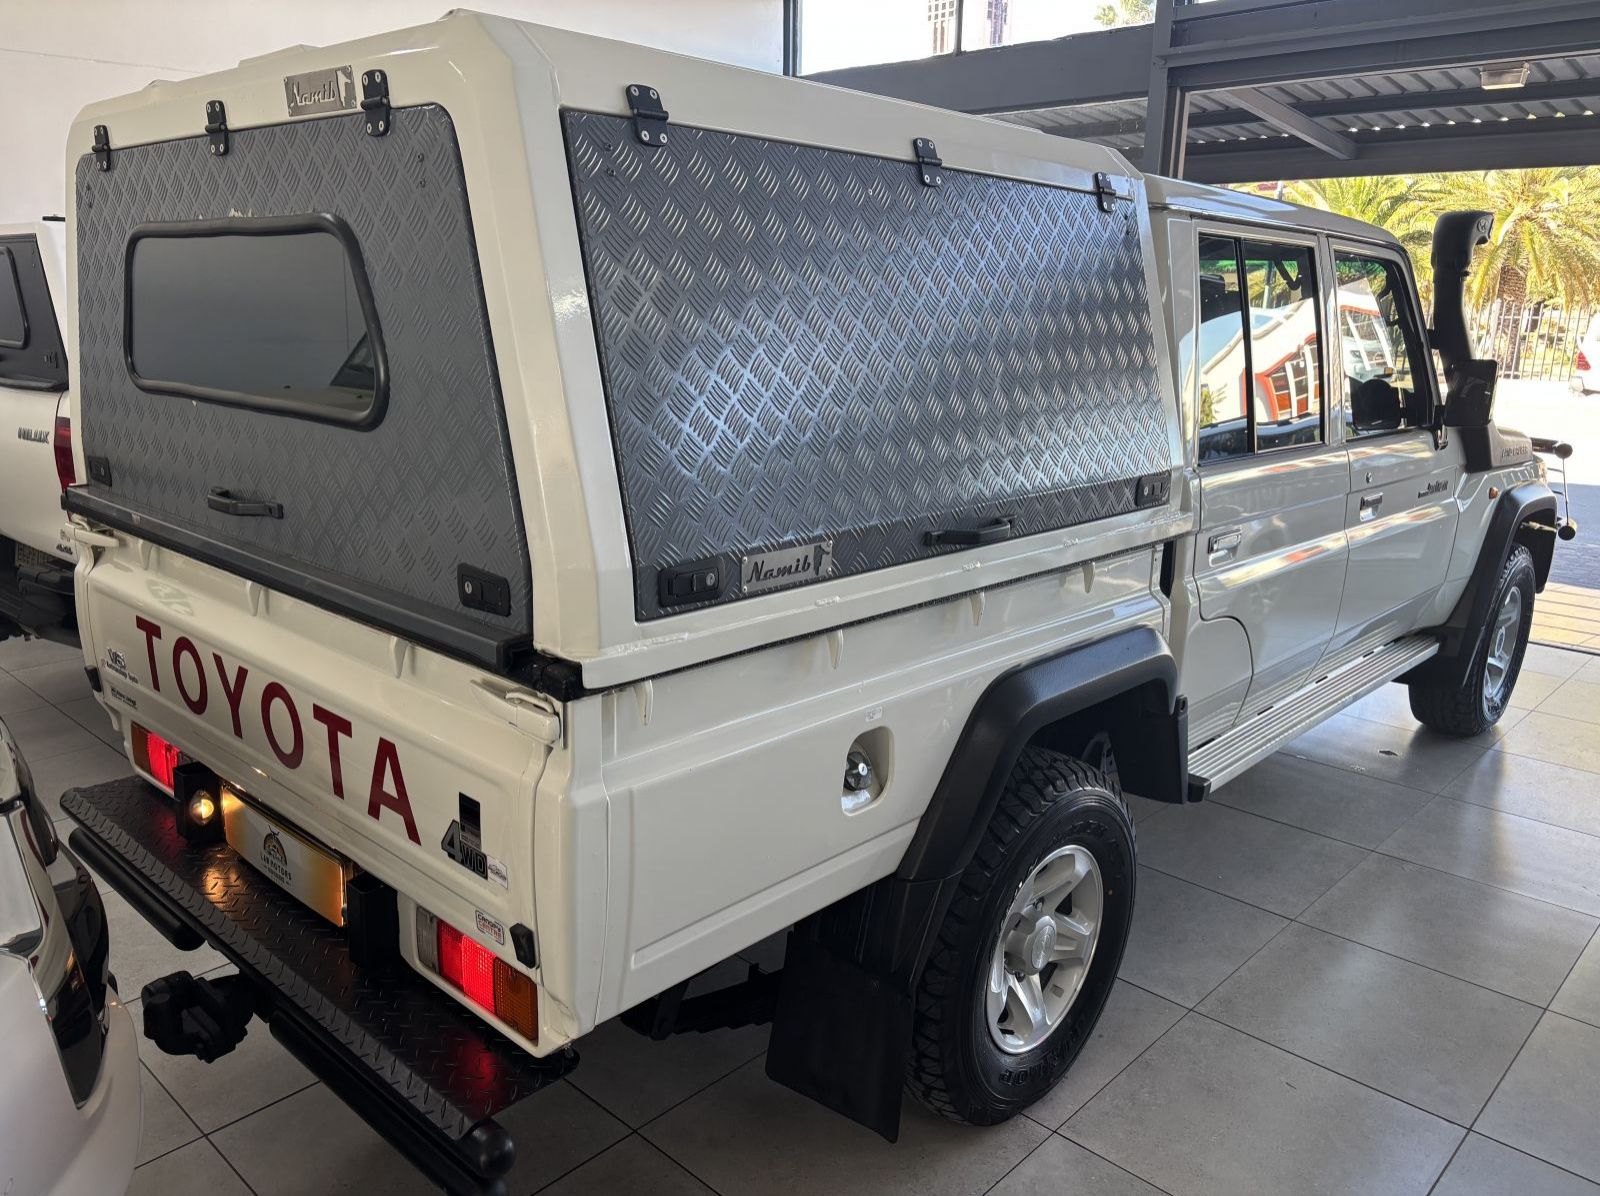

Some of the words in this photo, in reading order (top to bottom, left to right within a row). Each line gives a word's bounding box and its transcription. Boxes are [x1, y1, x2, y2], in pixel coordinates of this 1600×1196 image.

[289, 79, 337, 107] Namib
[746, 554, 811, 583] Namib
[136, 614, 422, 847] TOYOTA
[441, 819, 488, 880] 4WD
